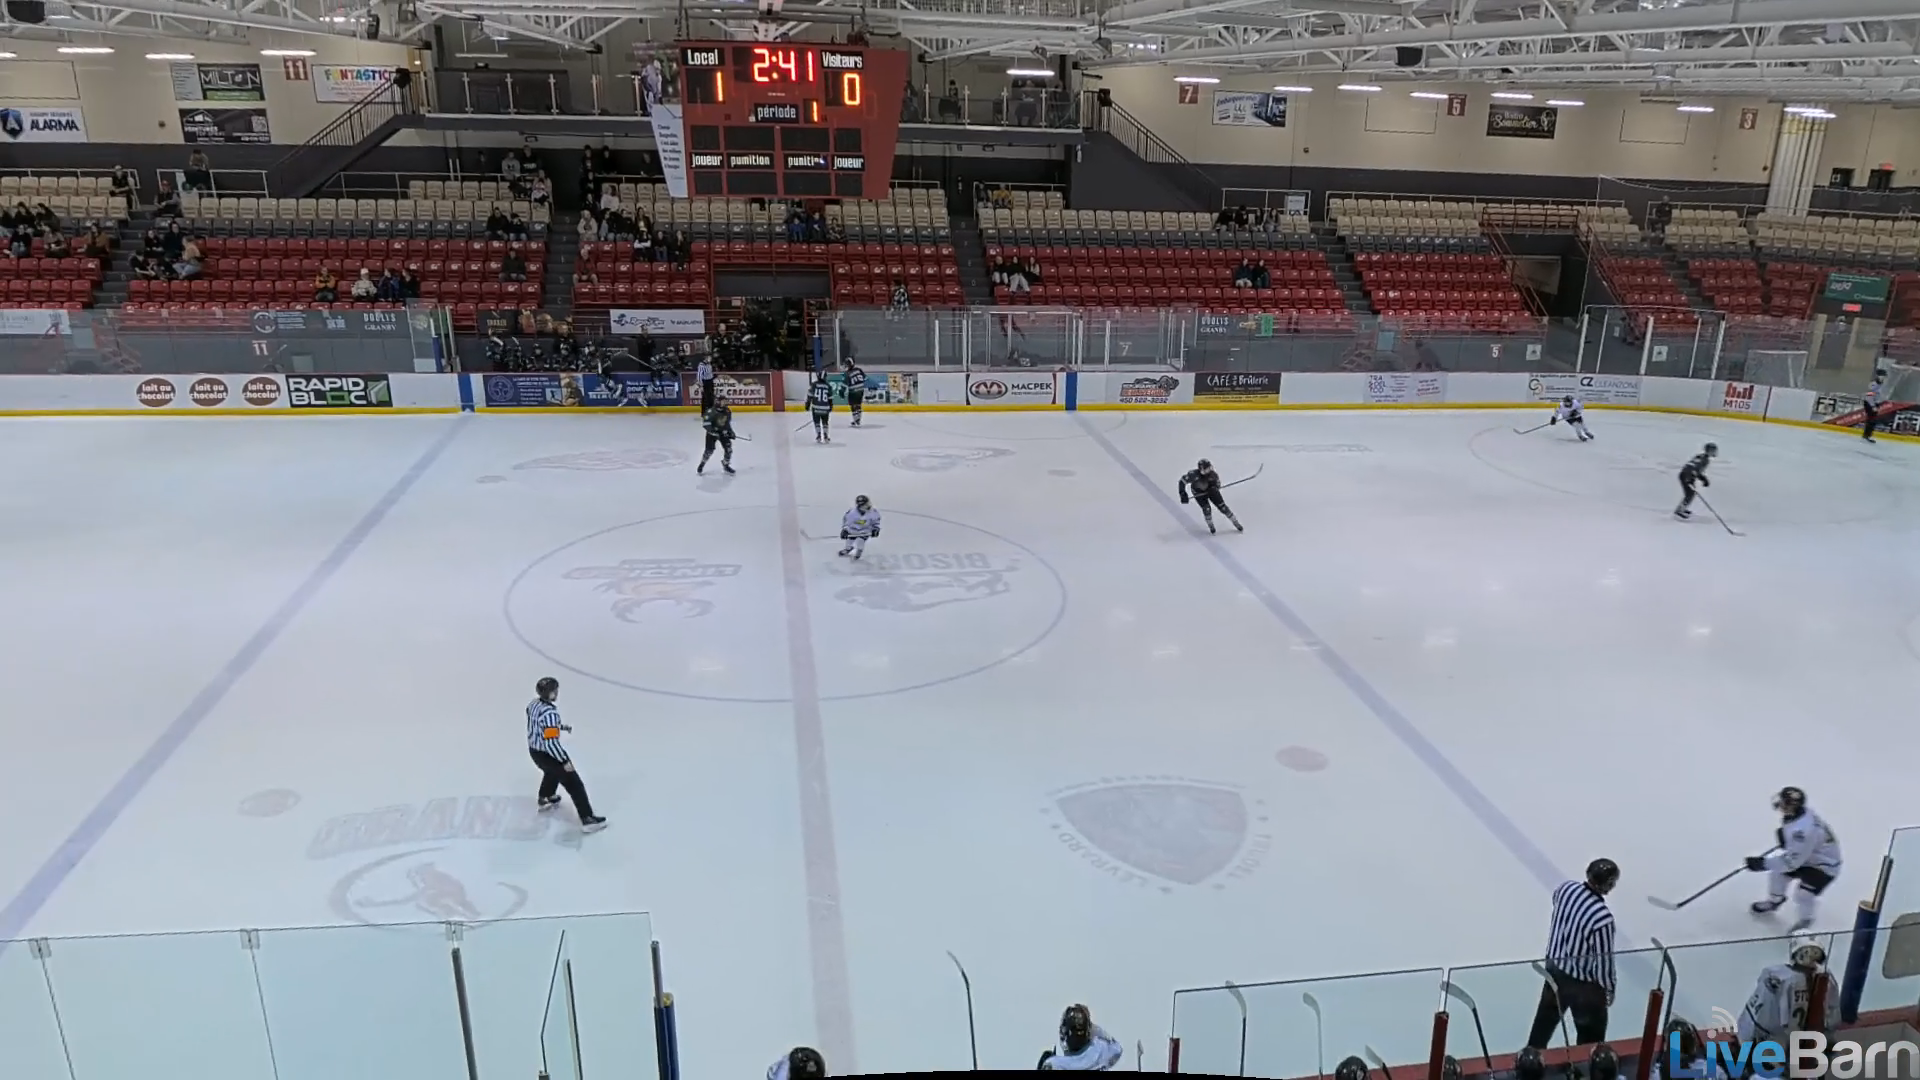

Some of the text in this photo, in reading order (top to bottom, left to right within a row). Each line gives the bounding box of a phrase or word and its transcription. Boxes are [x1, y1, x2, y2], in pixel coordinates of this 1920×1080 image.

[687, 49, 719, 66] Local
[822, 51, 863, 68] Visiteurs
[286, 60, 305, 79] 11
[753, 48, 813, 82] 2:41
[716, 71, 724, 102] 1
[843, 72, 861, 106] 0
[1184, 85, 1194, 104] 7
[757, 104, 797, 121] période
[812, 101, 818, 122] 1
[1452, 98, 1462, 116] 5
[30, 118, 80, 132] ALARMA
[1744, 110, 1753, 129] 3
[691, 153, 723, 168] joueur
[788, 154, 824, 168] puniti
[833, 155, 864, 170] joueur
[253, 344, 269, 356] 11
[683, 343, 691, 355] 9
[1491, 346, 1499, 358] 5
[142, 384, 158, 392] lait
[195, 383, 211, 391] lait
[248, 383, 264, 391] lait
[288, 377, 365, 391] RAPID
[1011, 382, 1053, 390] MACPEK
[1580, 377, 1594, 387] CZ
[1595, 380, 1639, 389] CLEANZONE
[243, 391, 279, 399] chocolat
[290, 391, 367, 405] BLOC
[814, 388, 829, 402] 46
[1723, 399, 1751, 410] M105
